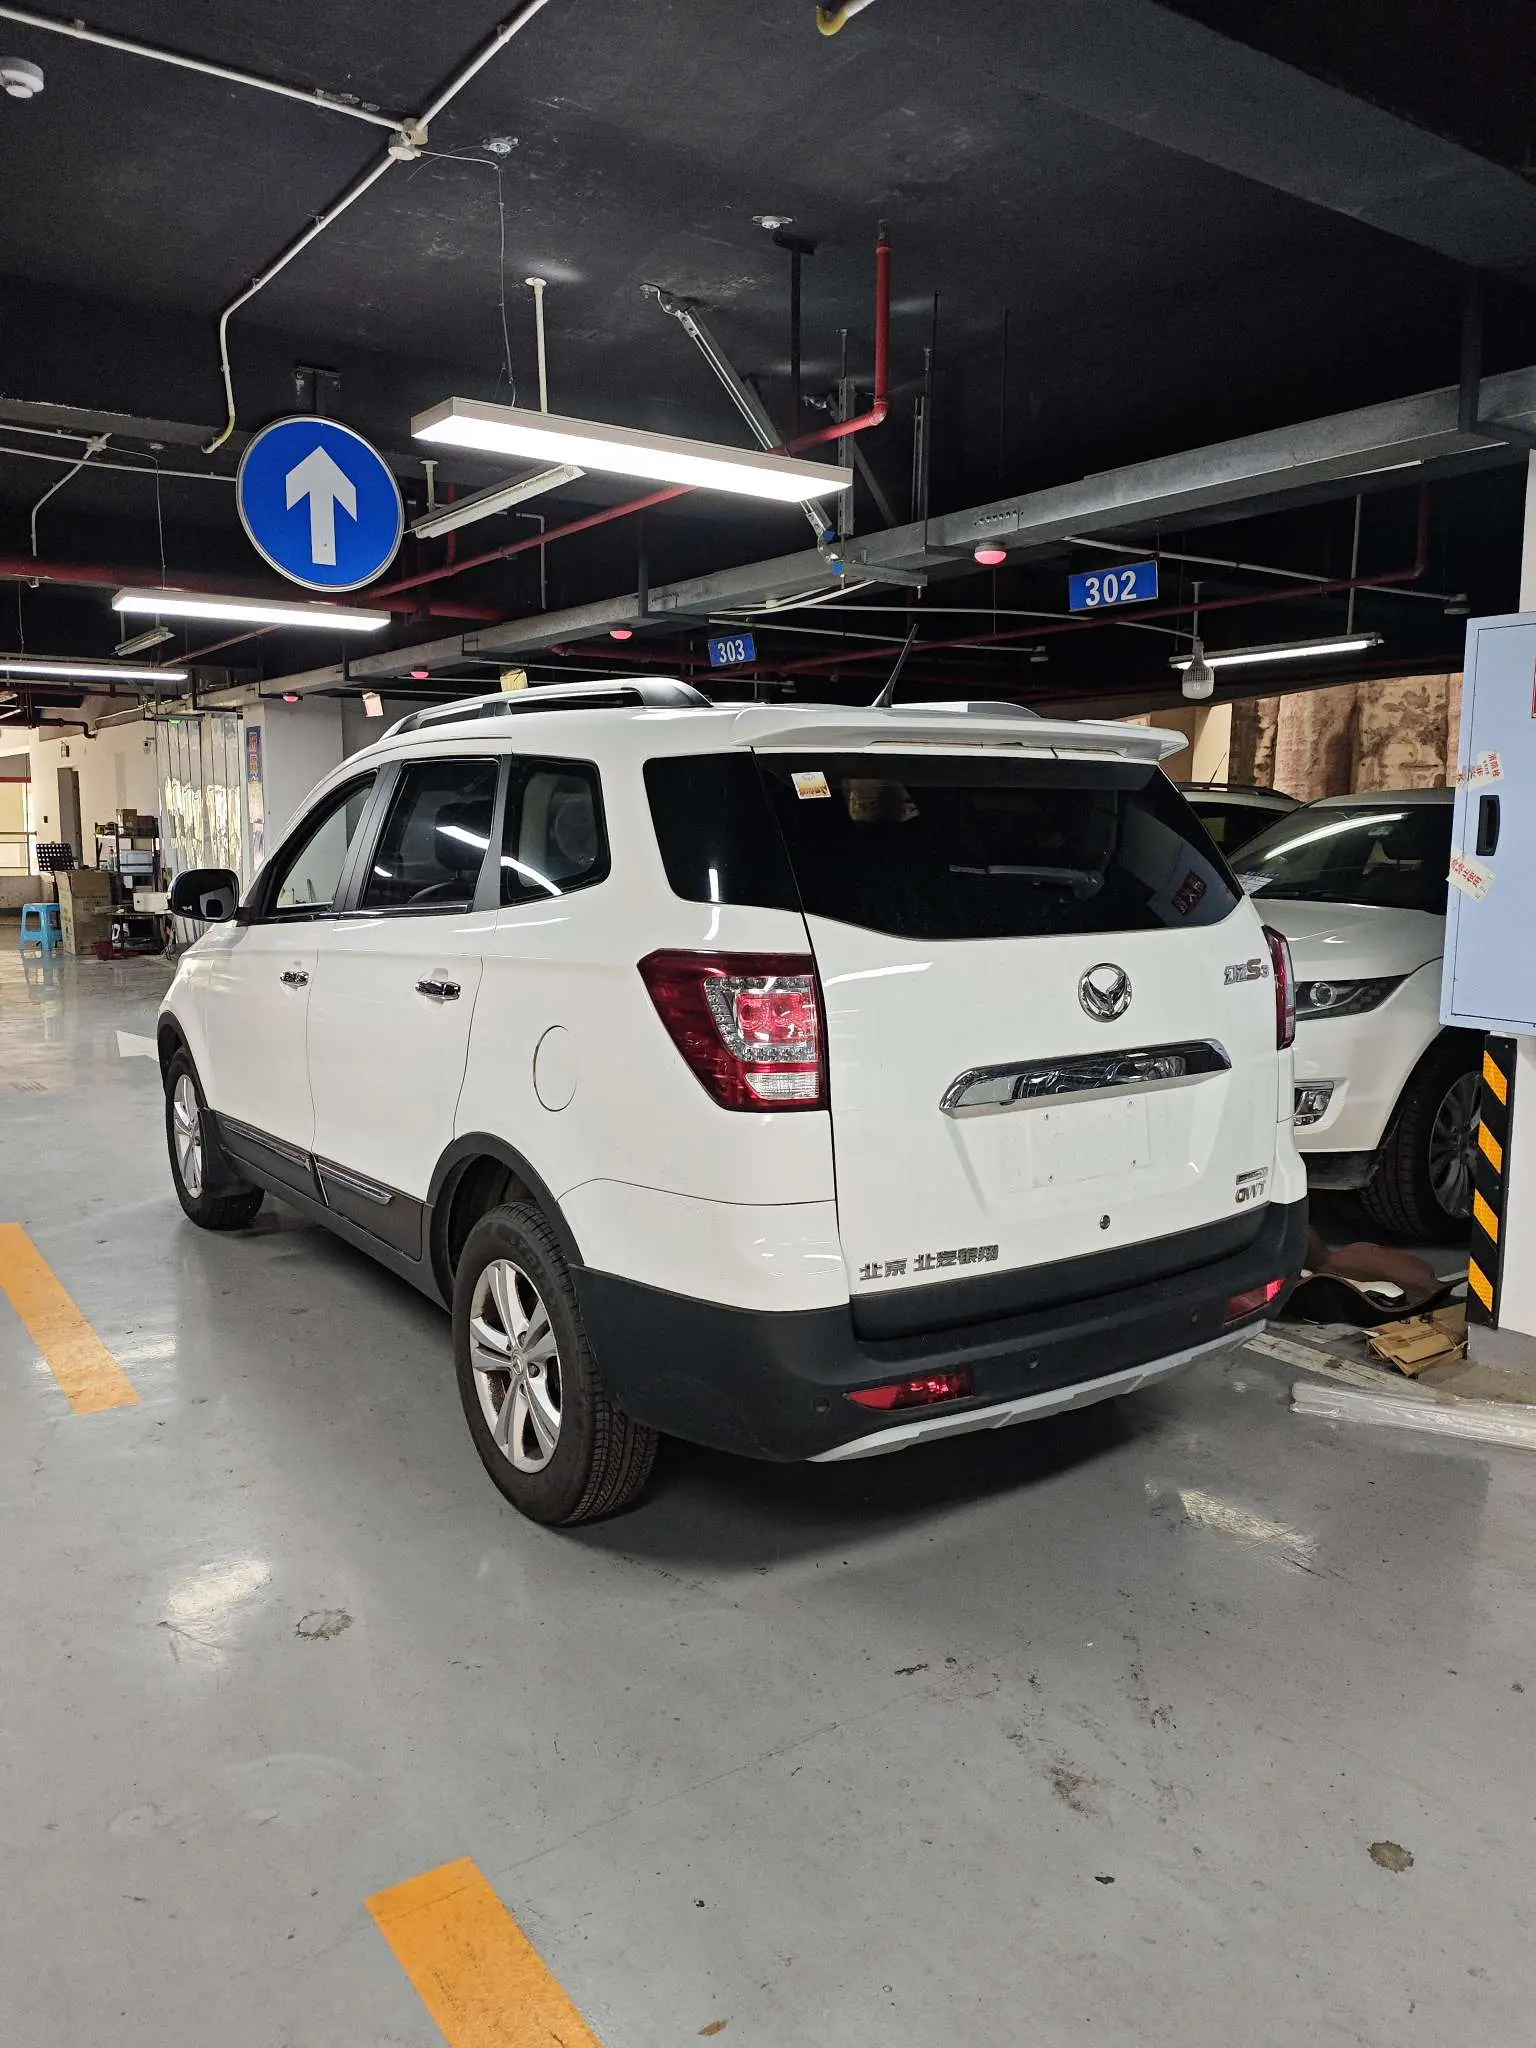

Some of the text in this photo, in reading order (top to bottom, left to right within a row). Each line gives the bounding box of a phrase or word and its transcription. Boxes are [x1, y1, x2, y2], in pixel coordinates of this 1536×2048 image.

[1084, 570, 1137, 607] 302
[717, 639, 746, 664] 303
[859, 1244, 999, 1281] 北京 北汽银翔
